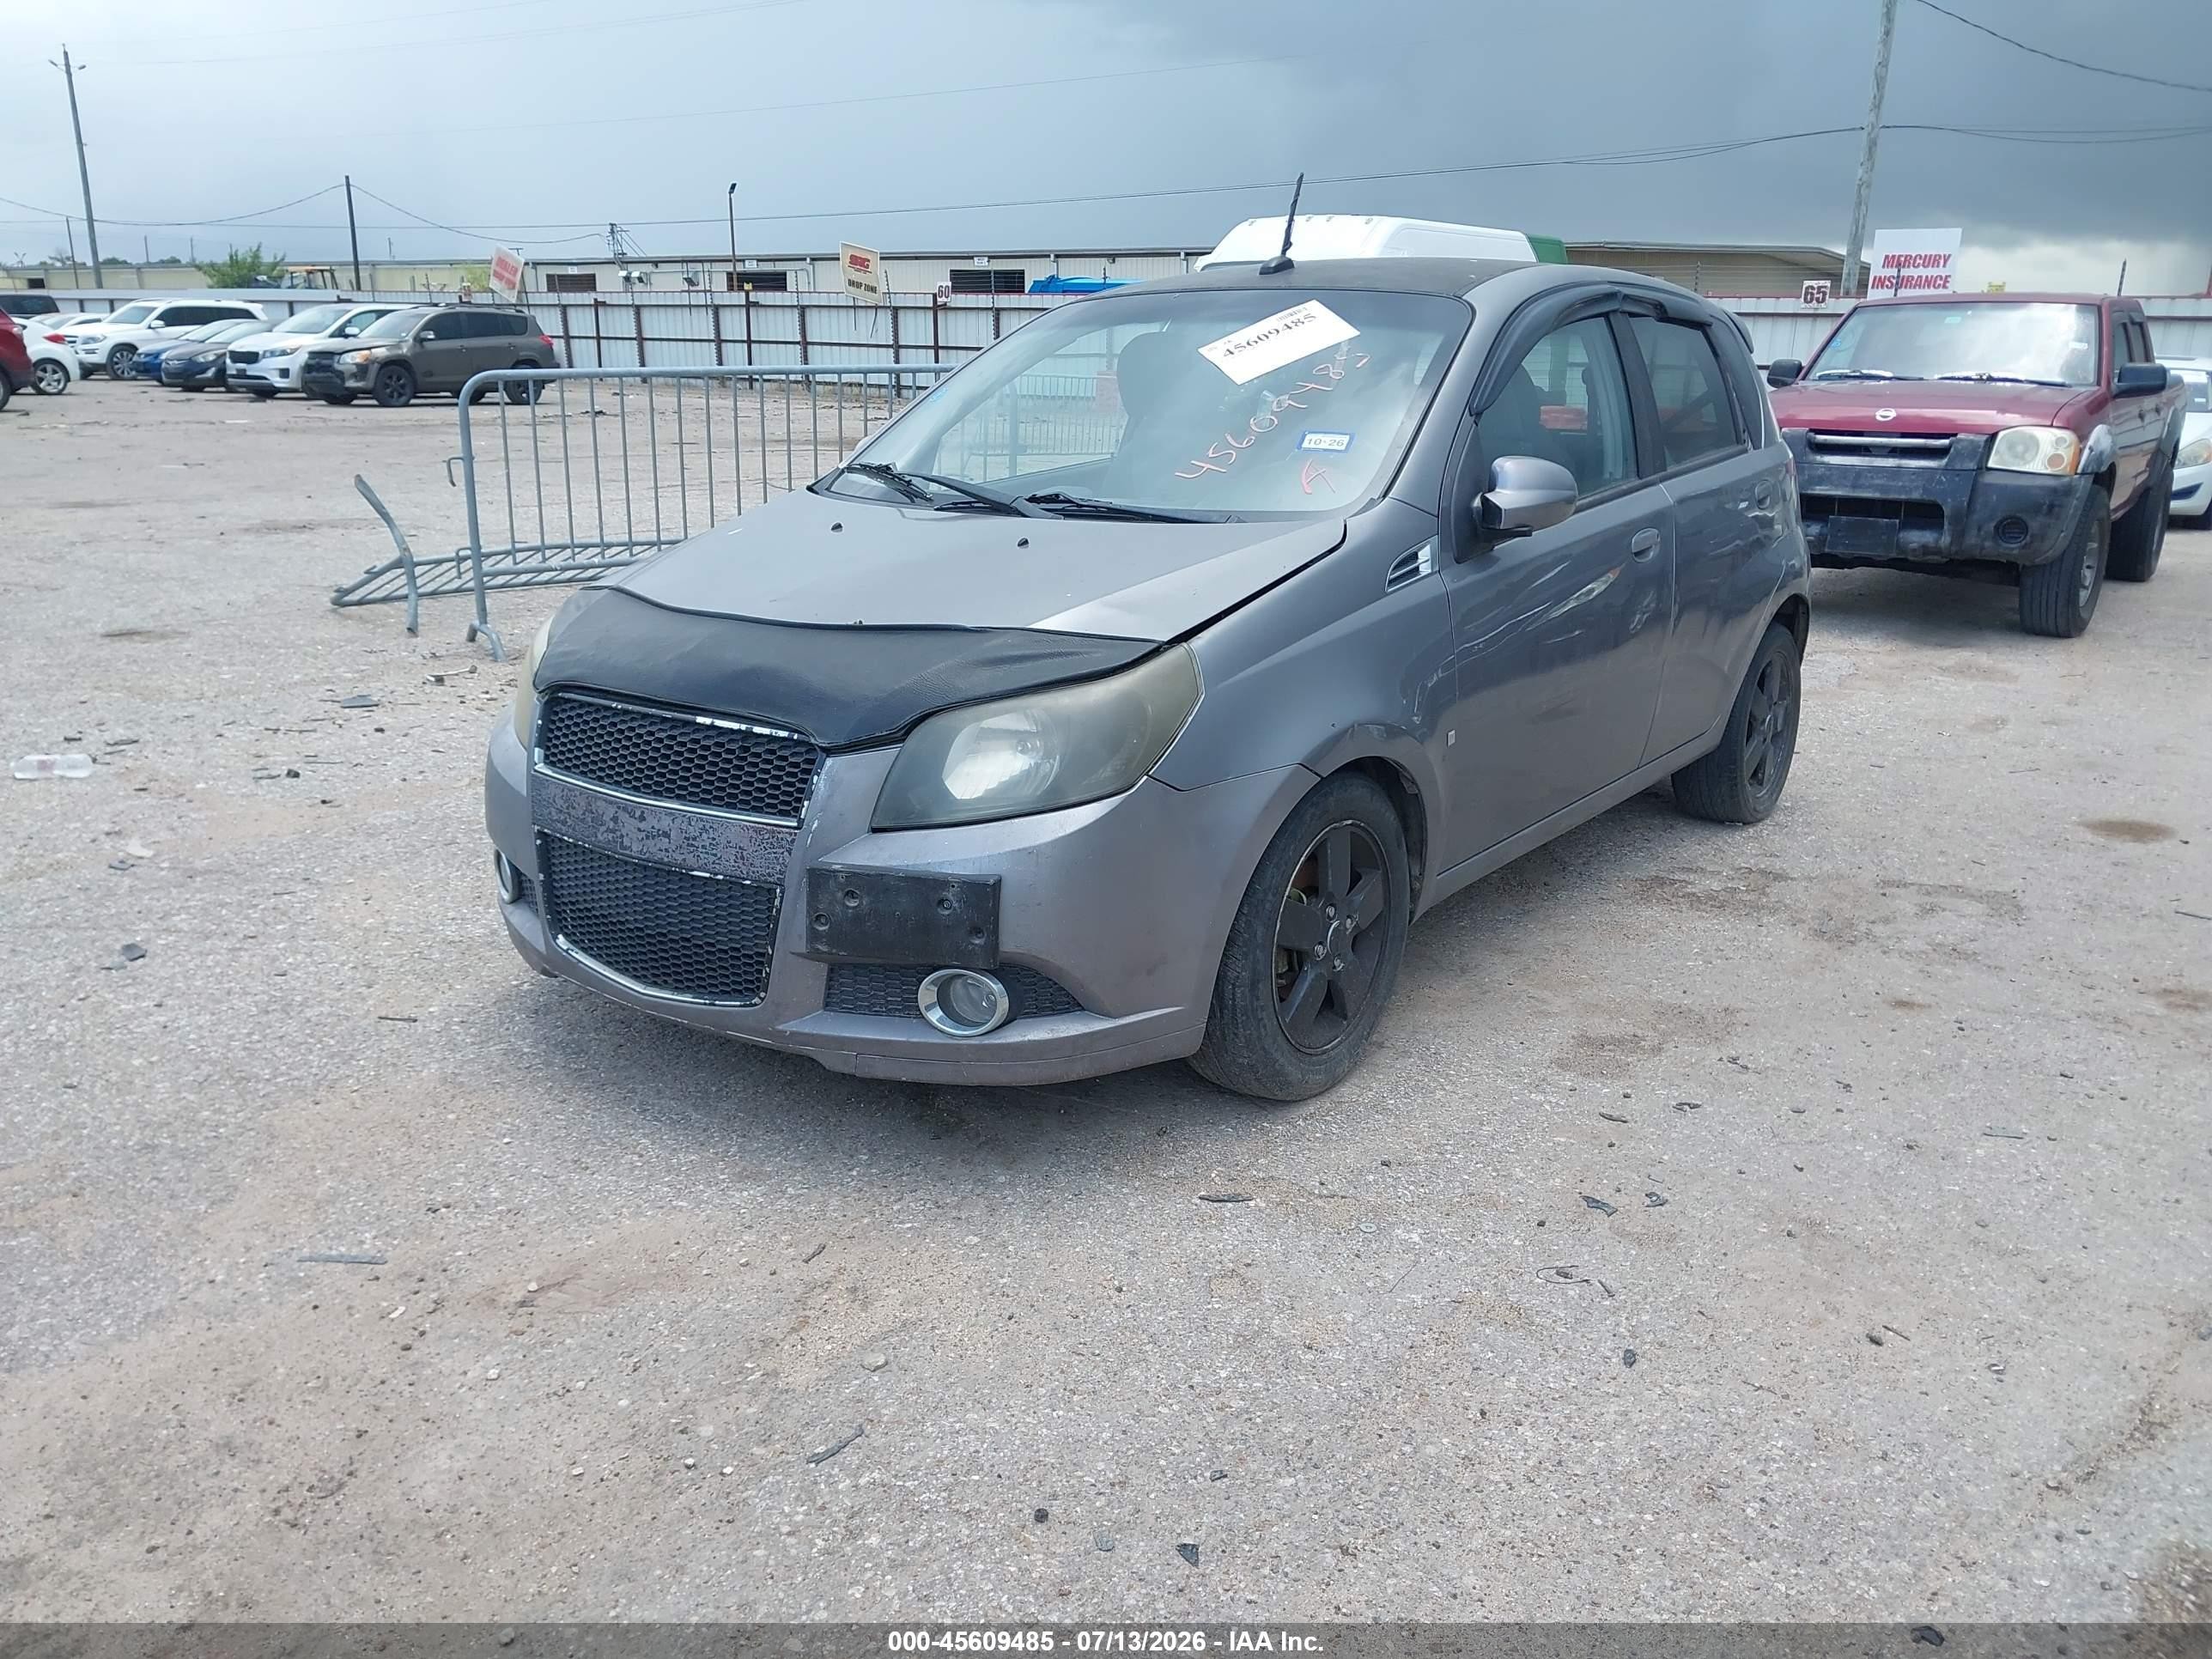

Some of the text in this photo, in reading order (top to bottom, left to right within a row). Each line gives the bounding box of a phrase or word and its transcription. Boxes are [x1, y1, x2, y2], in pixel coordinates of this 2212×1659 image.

[1882, 253, 1951, 269] MERCURY
[848, 278, 878, 294] DROP ZONE
[938, 285, 950, 298] 60
[1803, 285, 1828, 304] 65
[1224, 313, 1316, 357] 45609485
